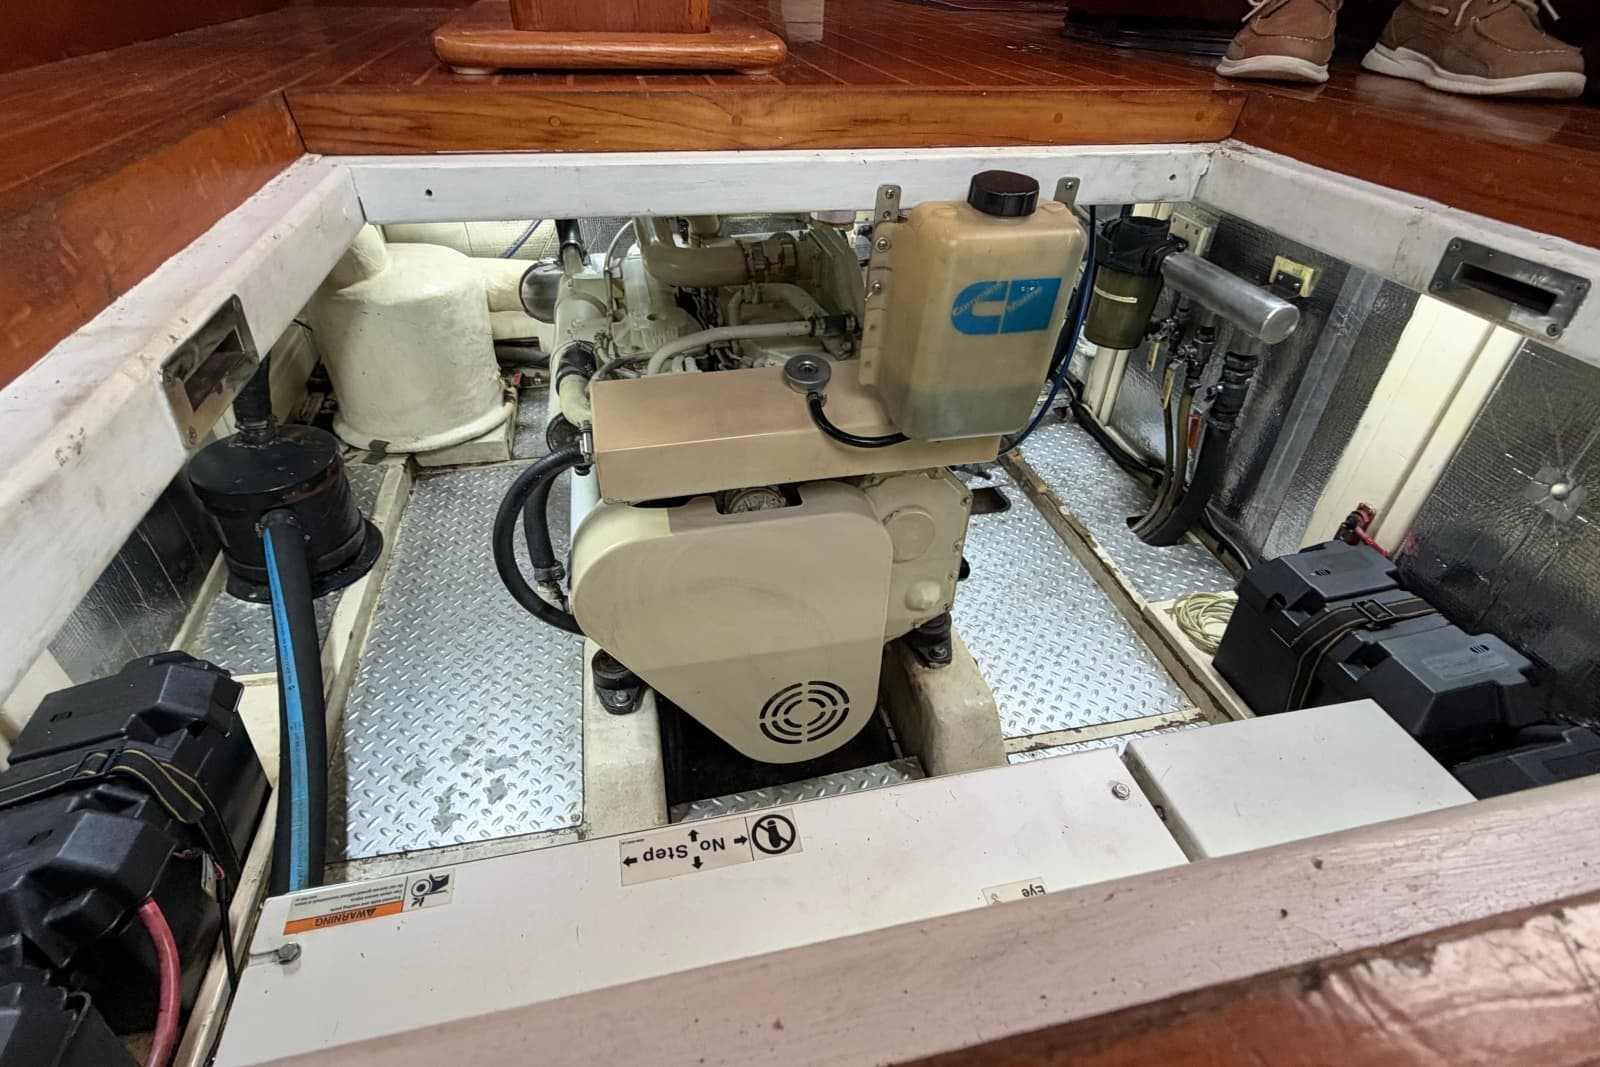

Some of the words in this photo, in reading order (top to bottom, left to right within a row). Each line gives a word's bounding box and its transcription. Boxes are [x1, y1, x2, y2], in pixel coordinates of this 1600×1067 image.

[700, 837, 725, 852] No
[643, 844, 688, 864] Step
[1021, 884, 1046, 898] Eye
[315, 909, 368, 927] WARNING
